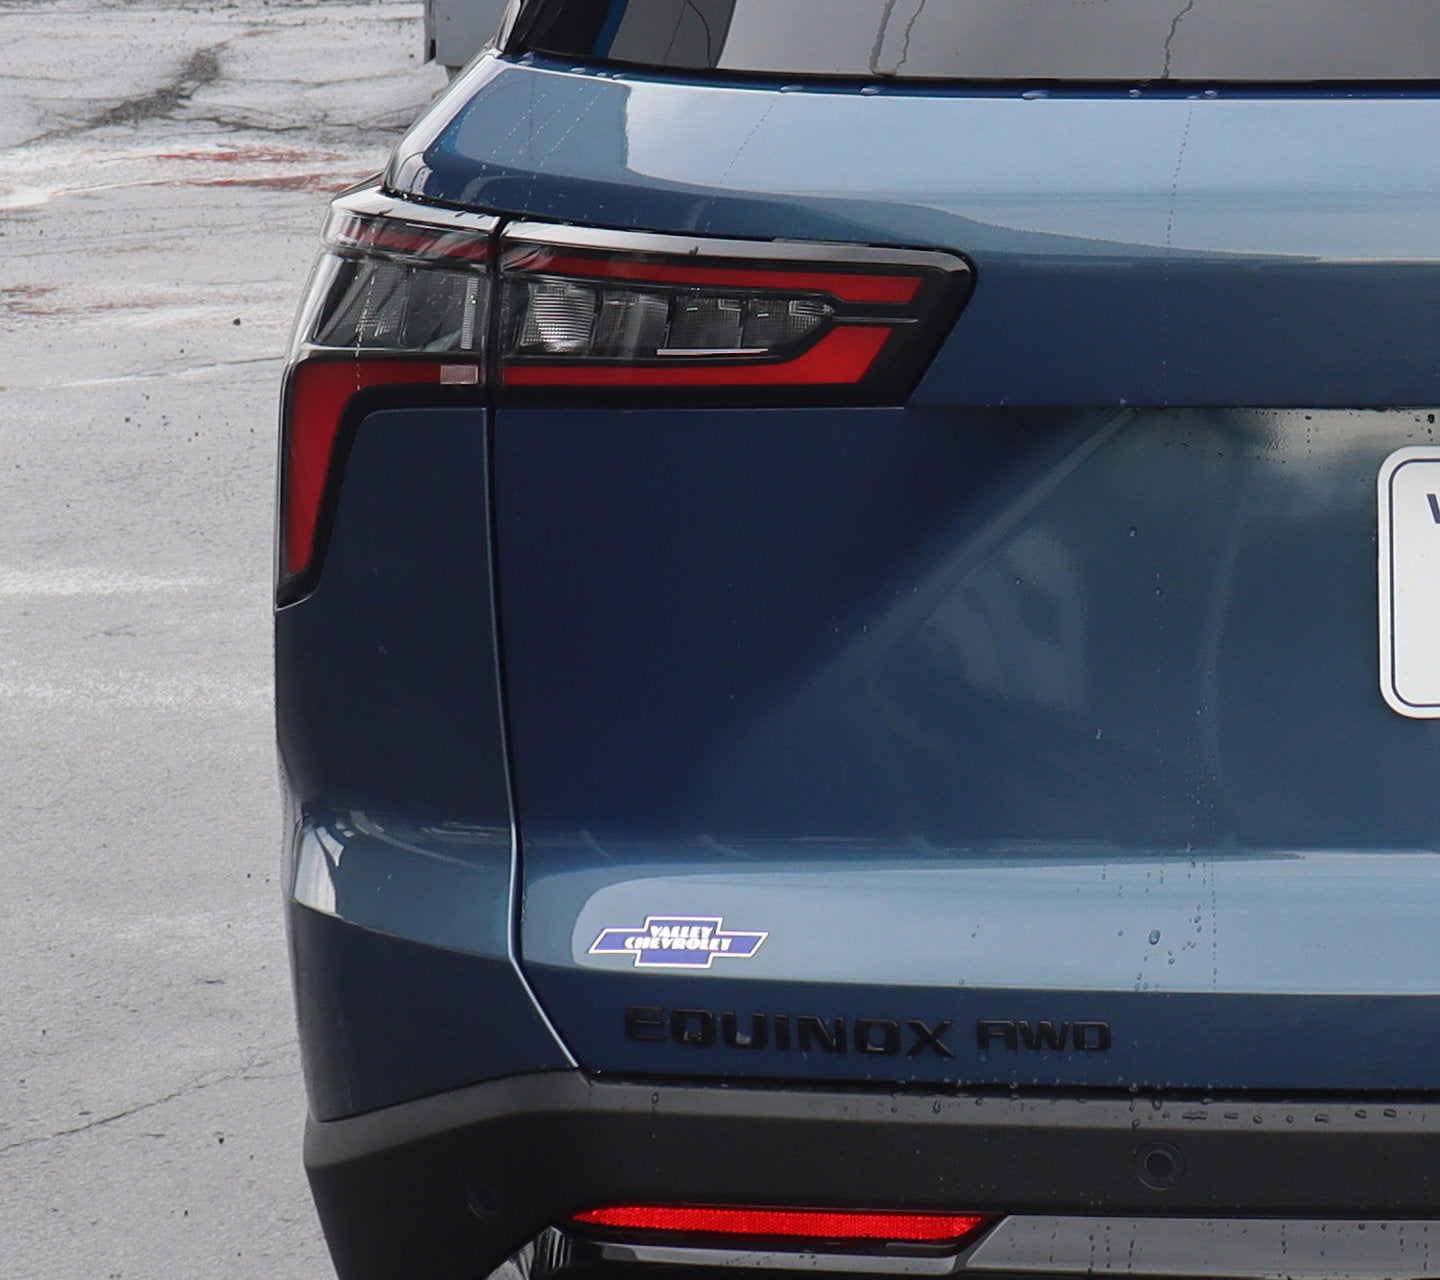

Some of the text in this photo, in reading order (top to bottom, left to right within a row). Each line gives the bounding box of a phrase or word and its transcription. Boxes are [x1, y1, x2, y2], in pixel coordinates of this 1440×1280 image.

[650, 925, 714, 939] VALLEY
[623, 936, 733, 951] CHEVROLET
[623, 1004, 1114, 1059] EQUINOX AWD
